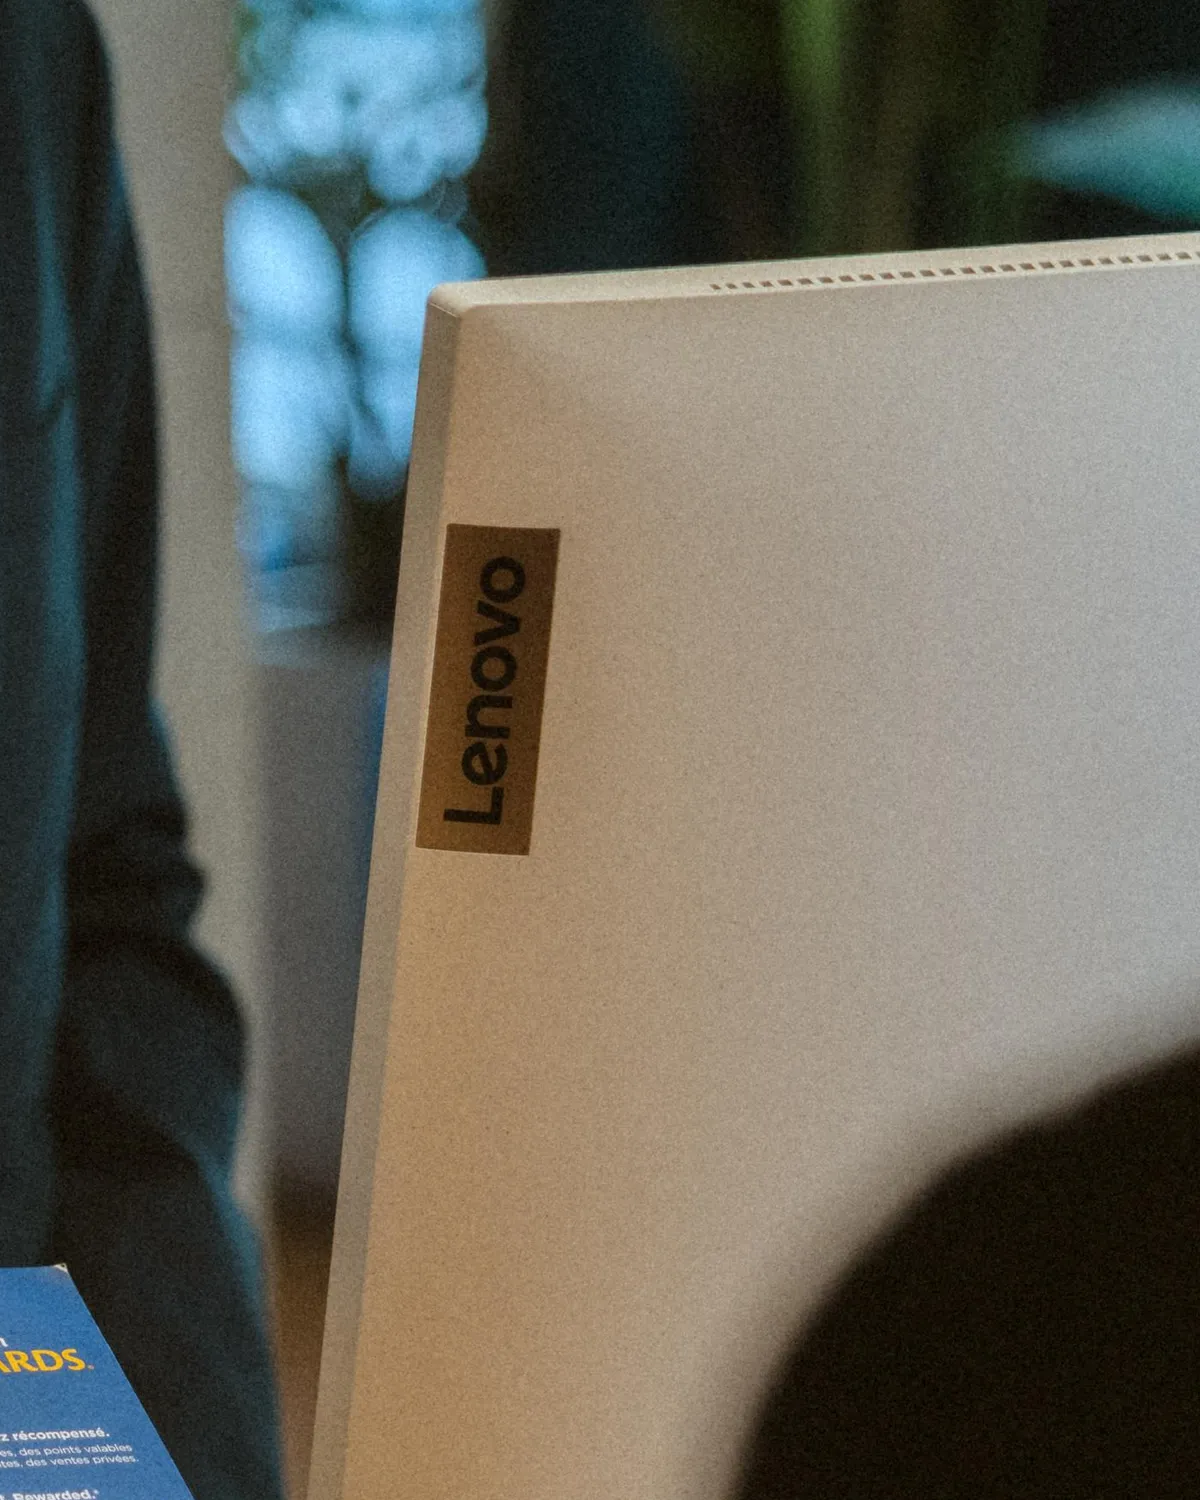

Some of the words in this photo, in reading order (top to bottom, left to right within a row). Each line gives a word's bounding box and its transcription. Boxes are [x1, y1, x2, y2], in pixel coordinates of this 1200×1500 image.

[443, 556, 526, 826] Lenovo
[12, 1427, 110, 1442] récompensé.
[19, 1446, 41, 1457] des
[44, 1444, 81, 1457] points
[83, 1442, 132, 1454] valables
[26, 1456, 47, 1468] des
[50, 1455, 89, 1466] ventes
[92, 1452, 139, 1466] privées.
